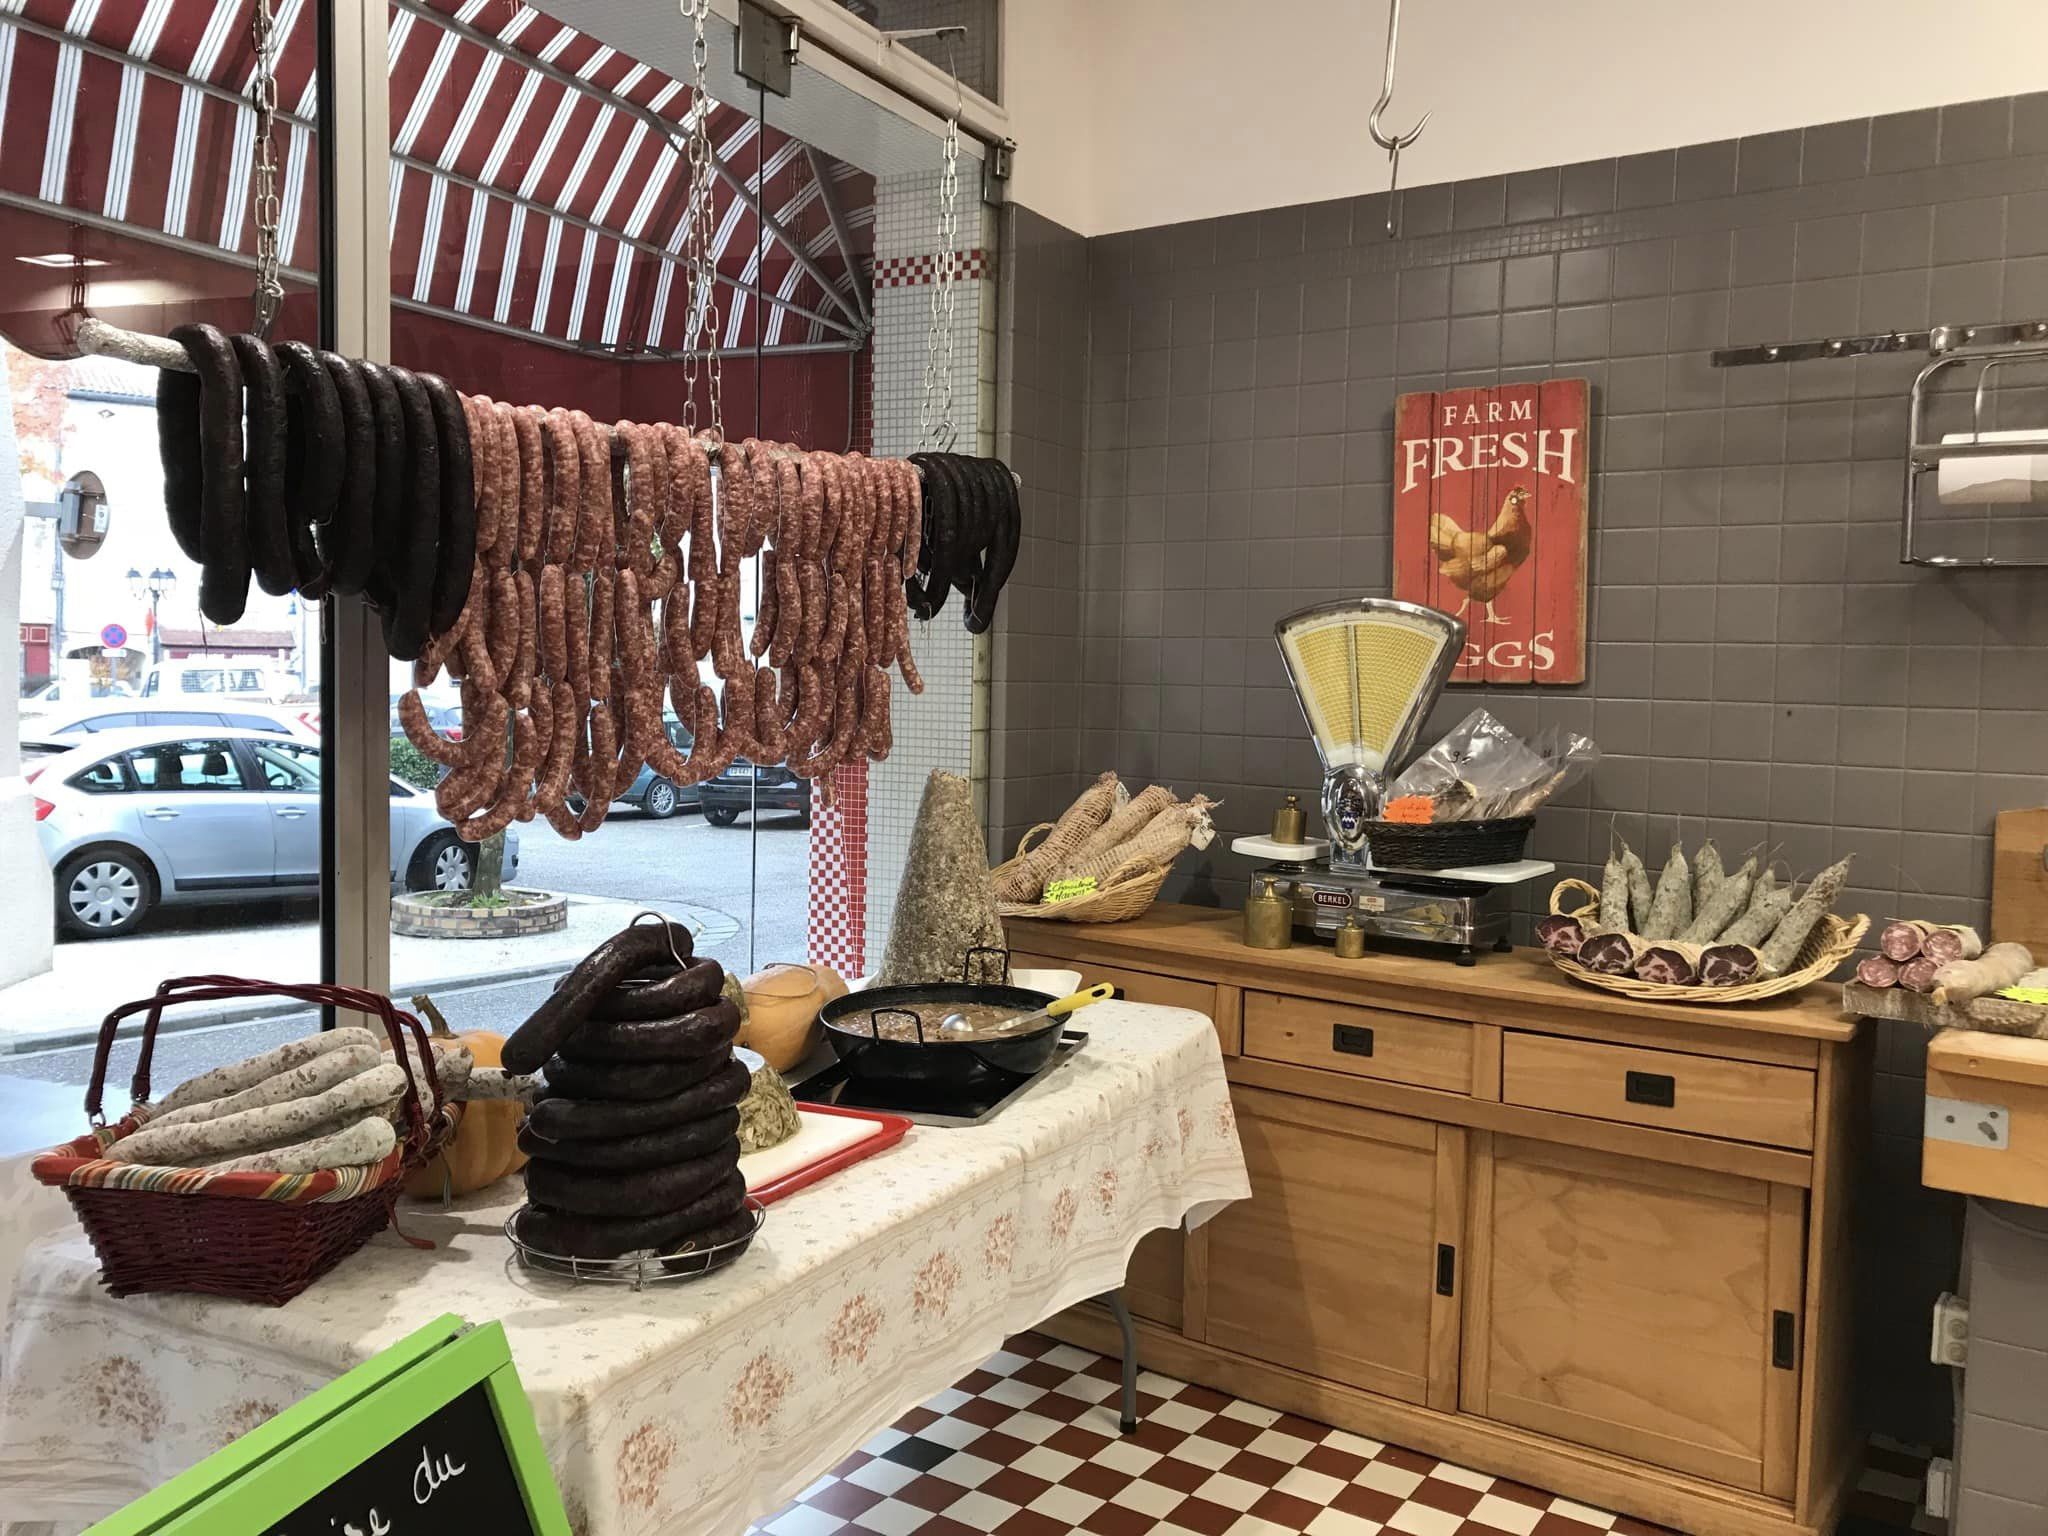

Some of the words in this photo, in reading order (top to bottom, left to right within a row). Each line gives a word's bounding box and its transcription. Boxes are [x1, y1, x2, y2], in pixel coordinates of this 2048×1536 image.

[1443, 399, 1533, 427] FARM
[1401, 427, 1578, 494] FRESH
[1455, 629, 1555, 671] GGS
[1317, 893, 1347, 906] BERKEL
[412, 1445, 467, 1505] du
